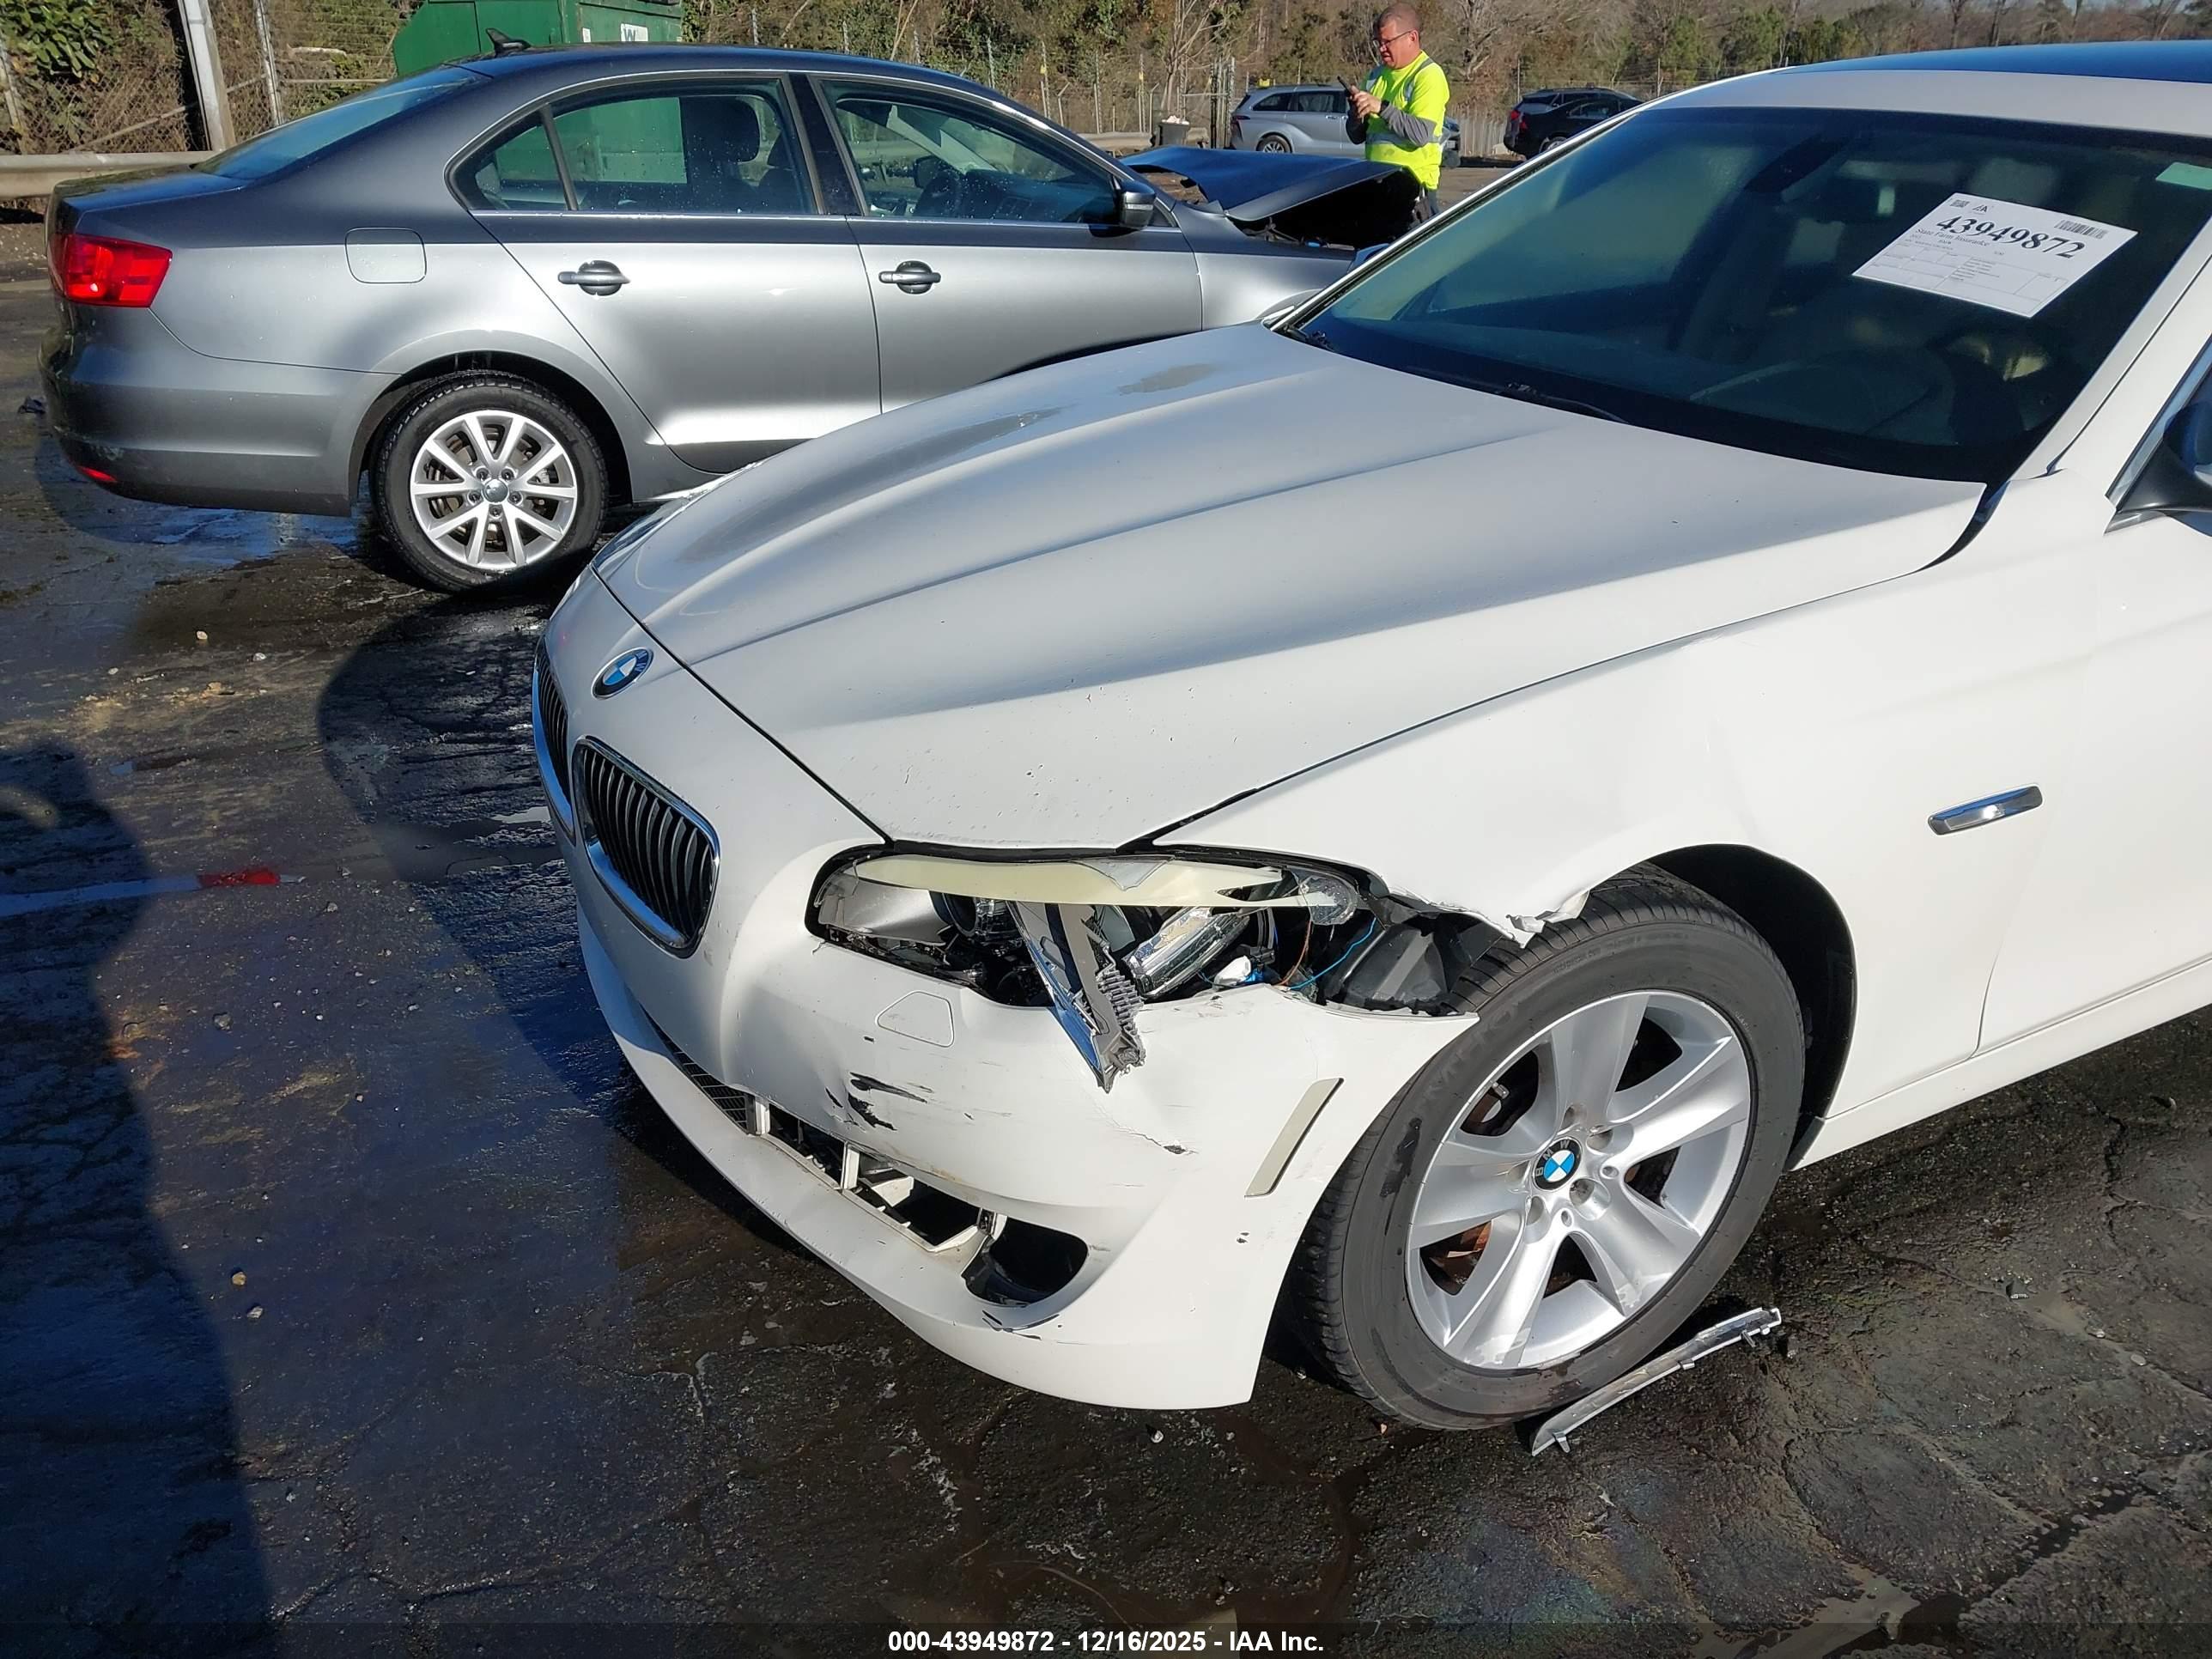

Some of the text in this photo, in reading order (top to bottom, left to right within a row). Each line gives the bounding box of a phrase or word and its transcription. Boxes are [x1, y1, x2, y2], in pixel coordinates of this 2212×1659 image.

[1915, 228, 1934, 236] State
[1935, 231, 1954, 240] Farm
[1936, 216, 2086, 259] 43949872
[1535, 1139, 1571, 1177] BMW
